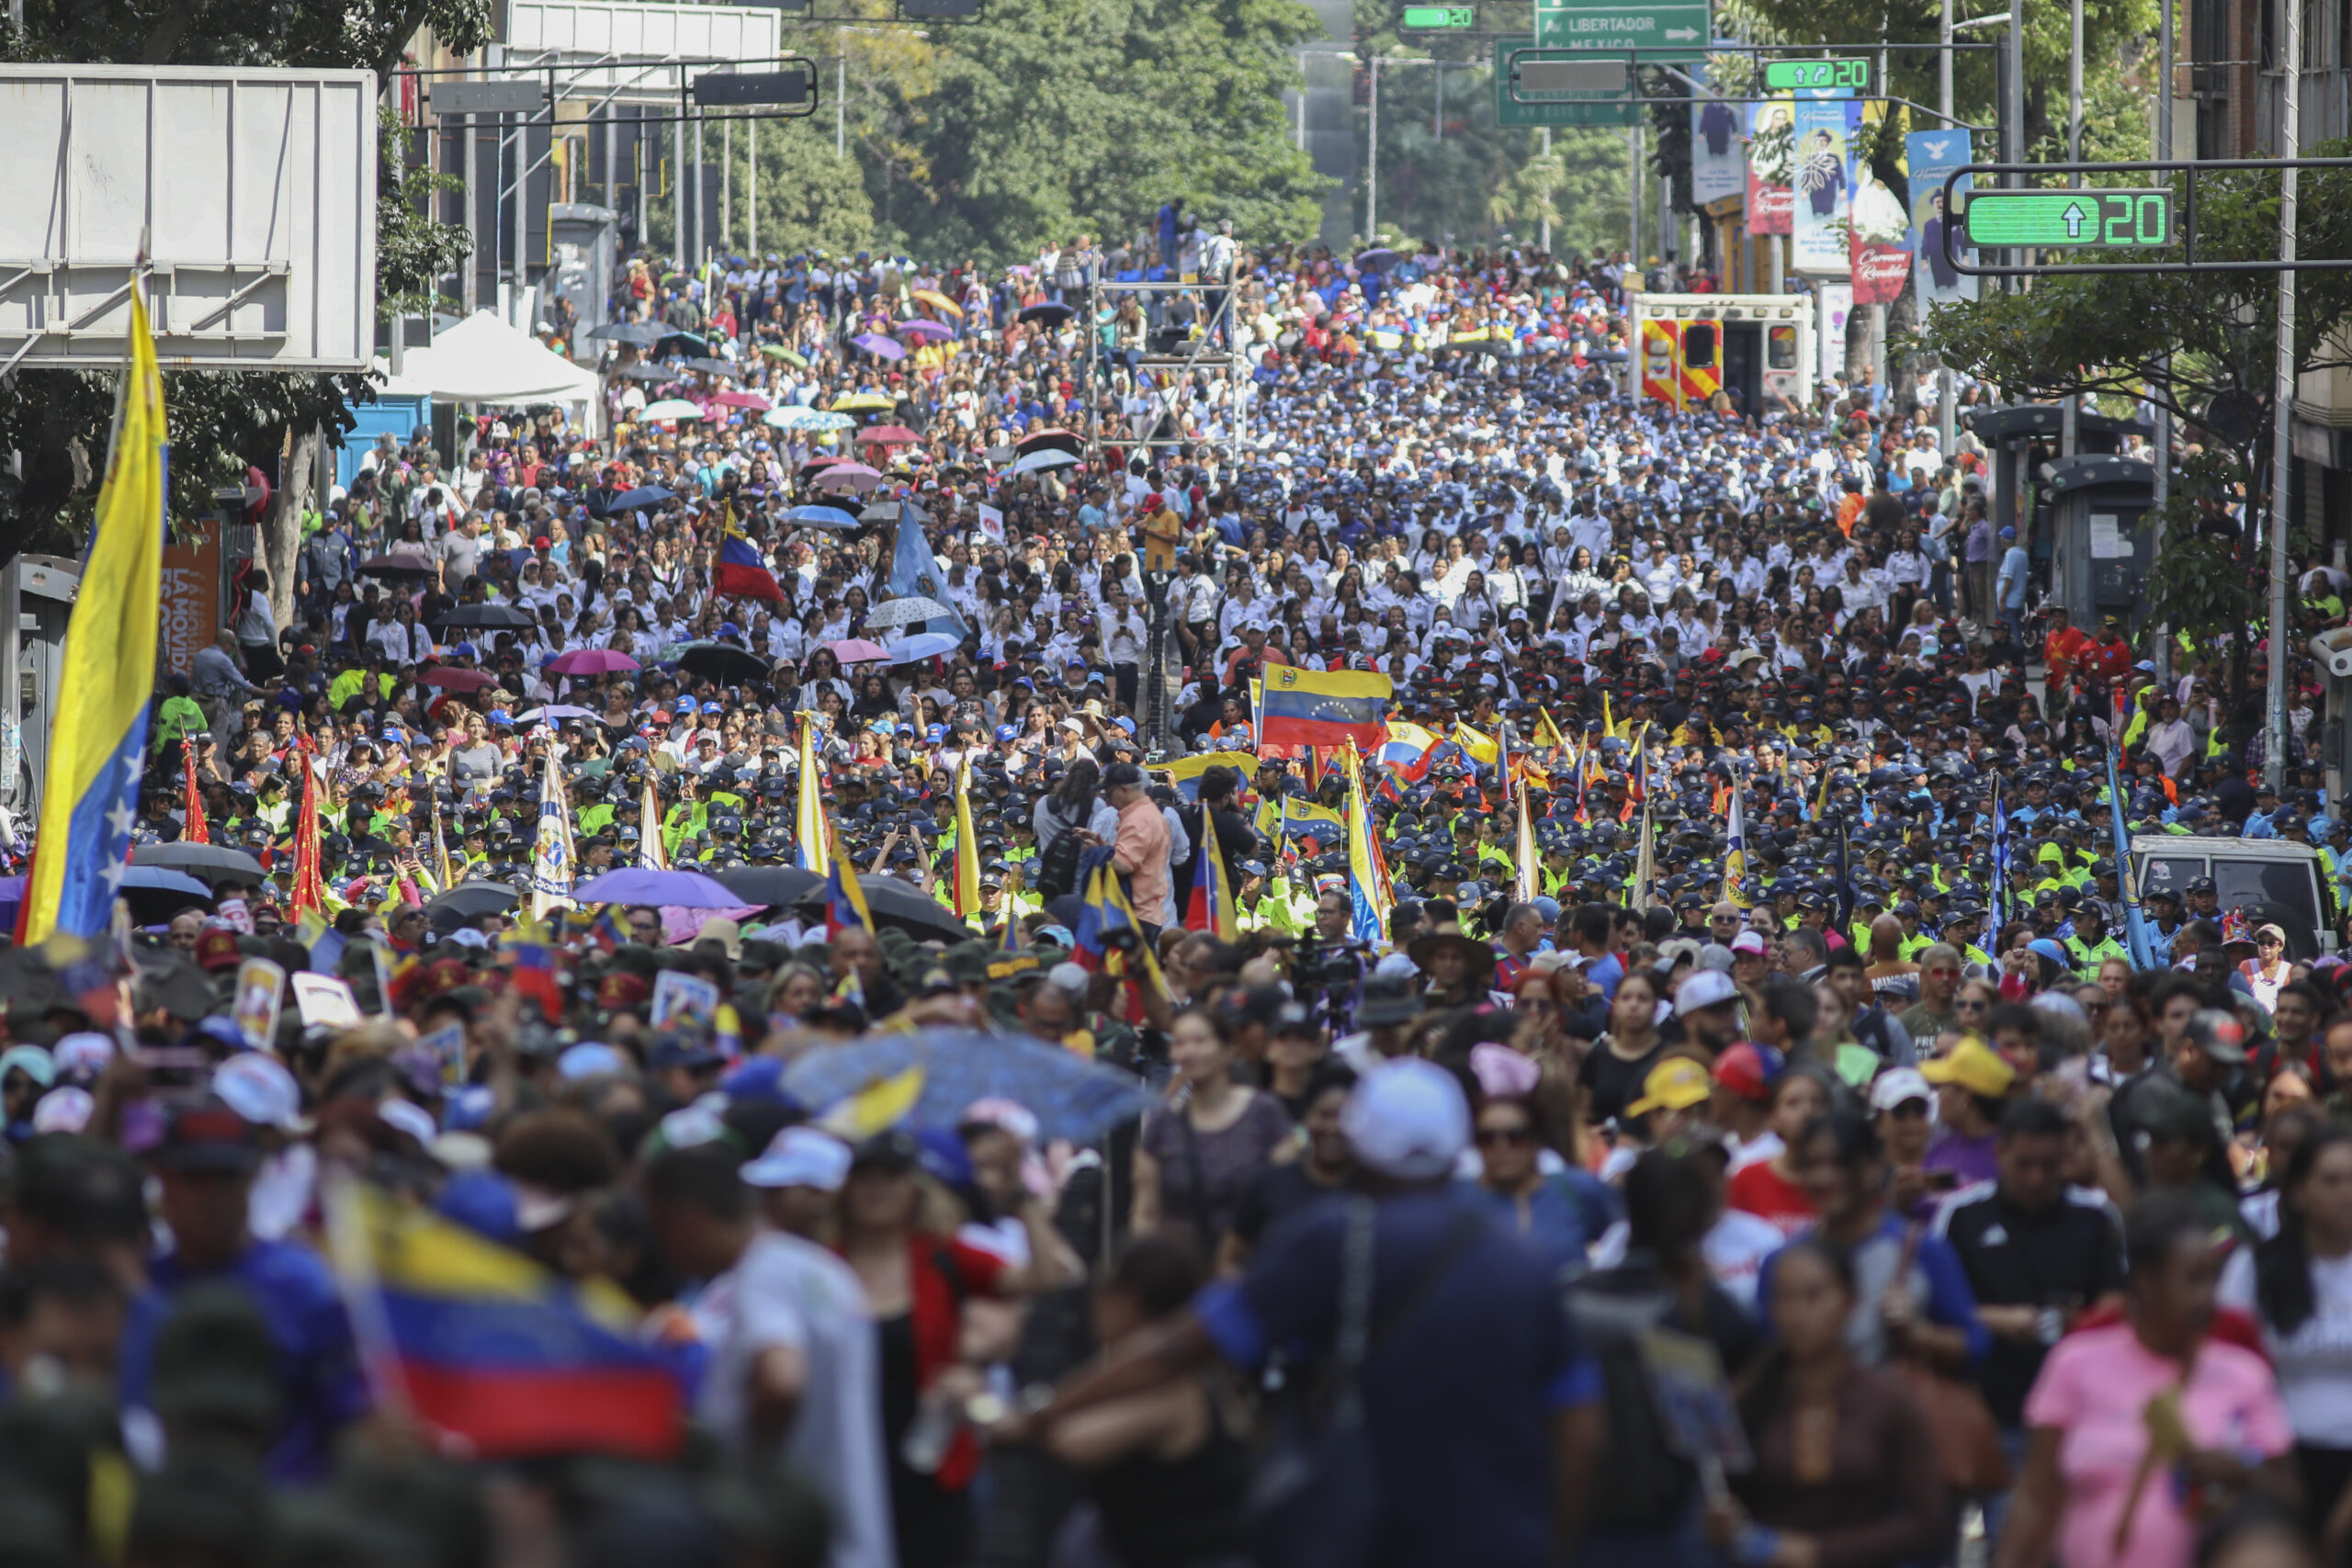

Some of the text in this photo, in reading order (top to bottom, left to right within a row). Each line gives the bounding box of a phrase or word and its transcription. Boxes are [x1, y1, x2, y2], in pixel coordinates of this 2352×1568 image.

[1451, 8, 1472, 28] 20
[1569, 17, 1656, 32] LIBERTADOR
[1835, 61, 1867, 87] 20
[2105, 195, 2165, 244] 20
[1858, 249, 1906, 265] Carmen
[173, 569, 189, 594] LA
